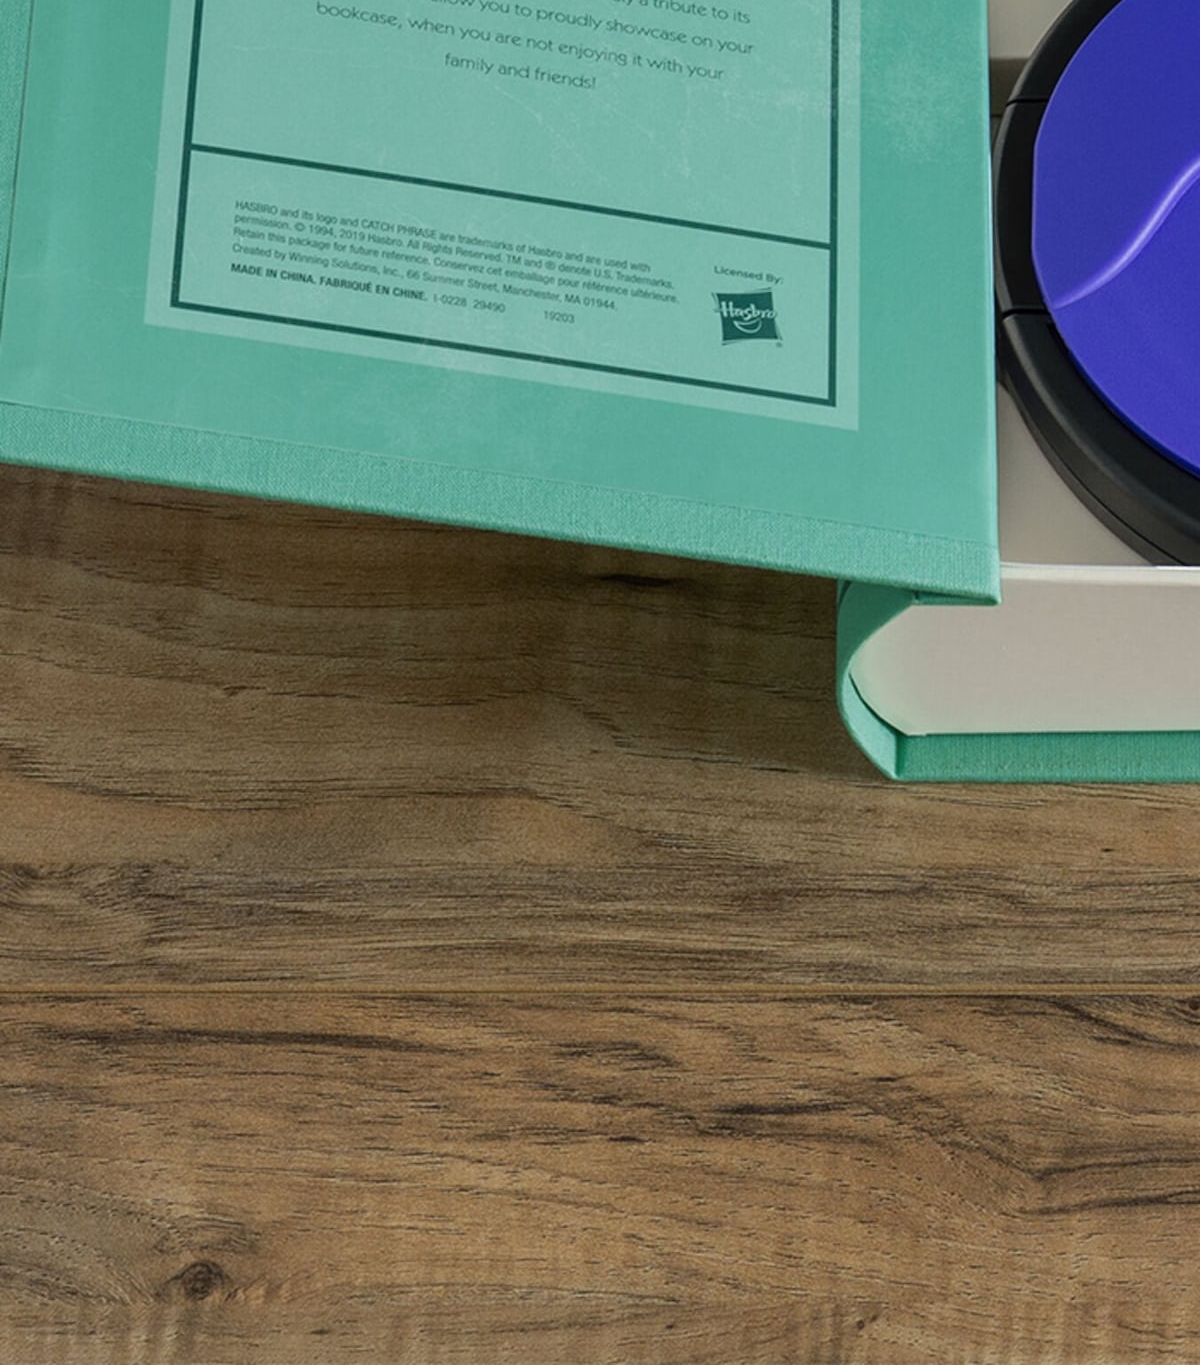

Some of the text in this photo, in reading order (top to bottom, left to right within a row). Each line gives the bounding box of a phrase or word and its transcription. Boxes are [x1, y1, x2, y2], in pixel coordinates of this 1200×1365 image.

[513, 3, 533, 18] to
[535, 8, 603, 31] proudly
[605, 18, 687, 44] showcase
[690, 34, 713, 48] on
[716, 38, 754, 54] your
[710, 5, 729, 20] to
[732, 8, 751, 24] its
[315, 0, 724, 80] bookcase, when you are not enjoying it with your
[444, 51, 596, 89] family and friends!
[232, 225, 265, 240] Retain
[266, 231, 286, 244] this
[287, 235, 331, 251] package
[348, 243, 379, 258] future
[234, 199, 651, 273] HASBRO and logo and CATCH PHRASE trademarks Hasbro and used with
[338, 228, 366, 242] 2019
[421, 240, 453, 255] Rights
[523, 257, 543, 269] and
[557, 262, 592, 276] denote
[230, 262, 262, 276] MADE
[264, 267, 278, 278] IN
[279, 269, 316, 285] CHINA.
[374, 283, 390, 295] EN
[231, 242, 272, 258] Created
[273, 248, 287, 262] by
[288, 250, 329, 268] Winning
[421, 270, 465, 287] Summer
[563, 292, 581, 305] MA
[713, 264, 763, 281] Licensed
[718, 301, 776, 320] Hasbro
